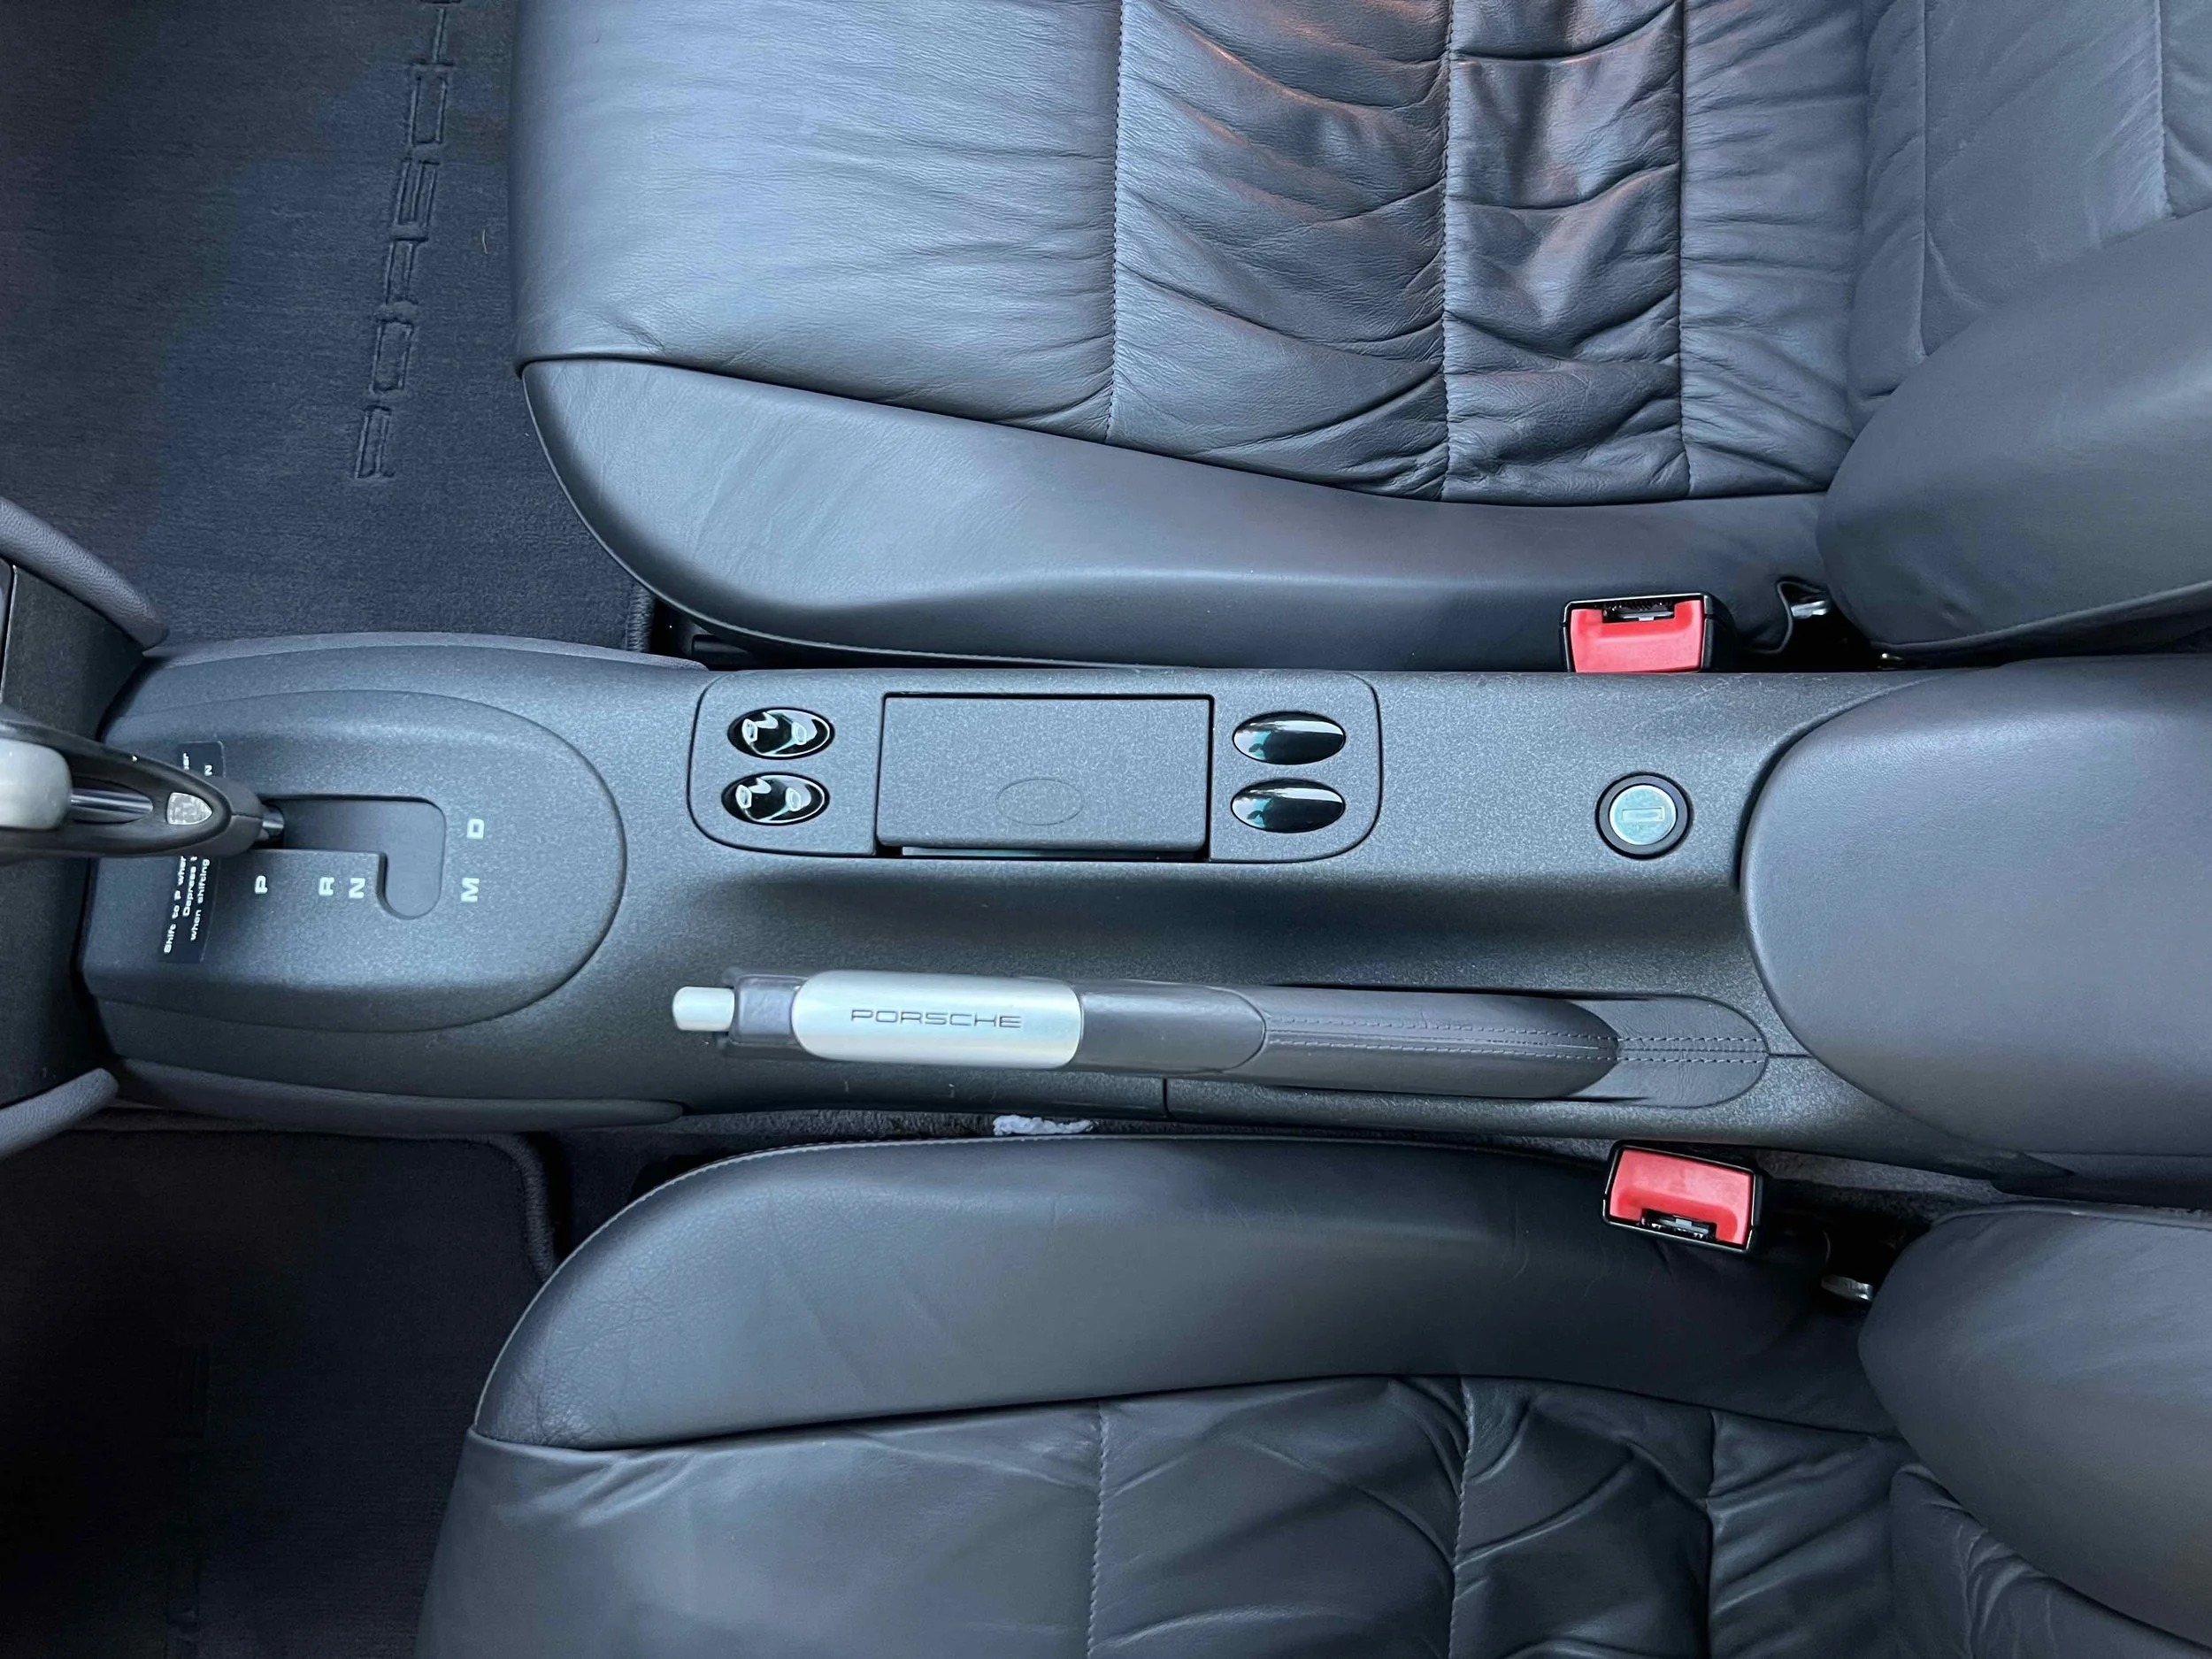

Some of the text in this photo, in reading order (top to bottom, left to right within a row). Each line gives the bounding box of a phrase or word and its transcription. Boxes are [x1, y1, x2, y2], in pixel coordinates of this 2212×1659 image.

[466, 818, 485, 840] D
[190, 764, 213, 941] when shifting N
[174, 890, 181, 901] P
[182, 866, 196, 917] Depress
[254, 875, 268, 895] P
[319, 877, 334, 896] R
[349, 877, 365, 899] N
[460, 877, 480, 902] M
[172, 905, 180, 919] to
[164, 924, 177, 953] Shift
[850, 1009, 1022, 1029] PORSCHE
